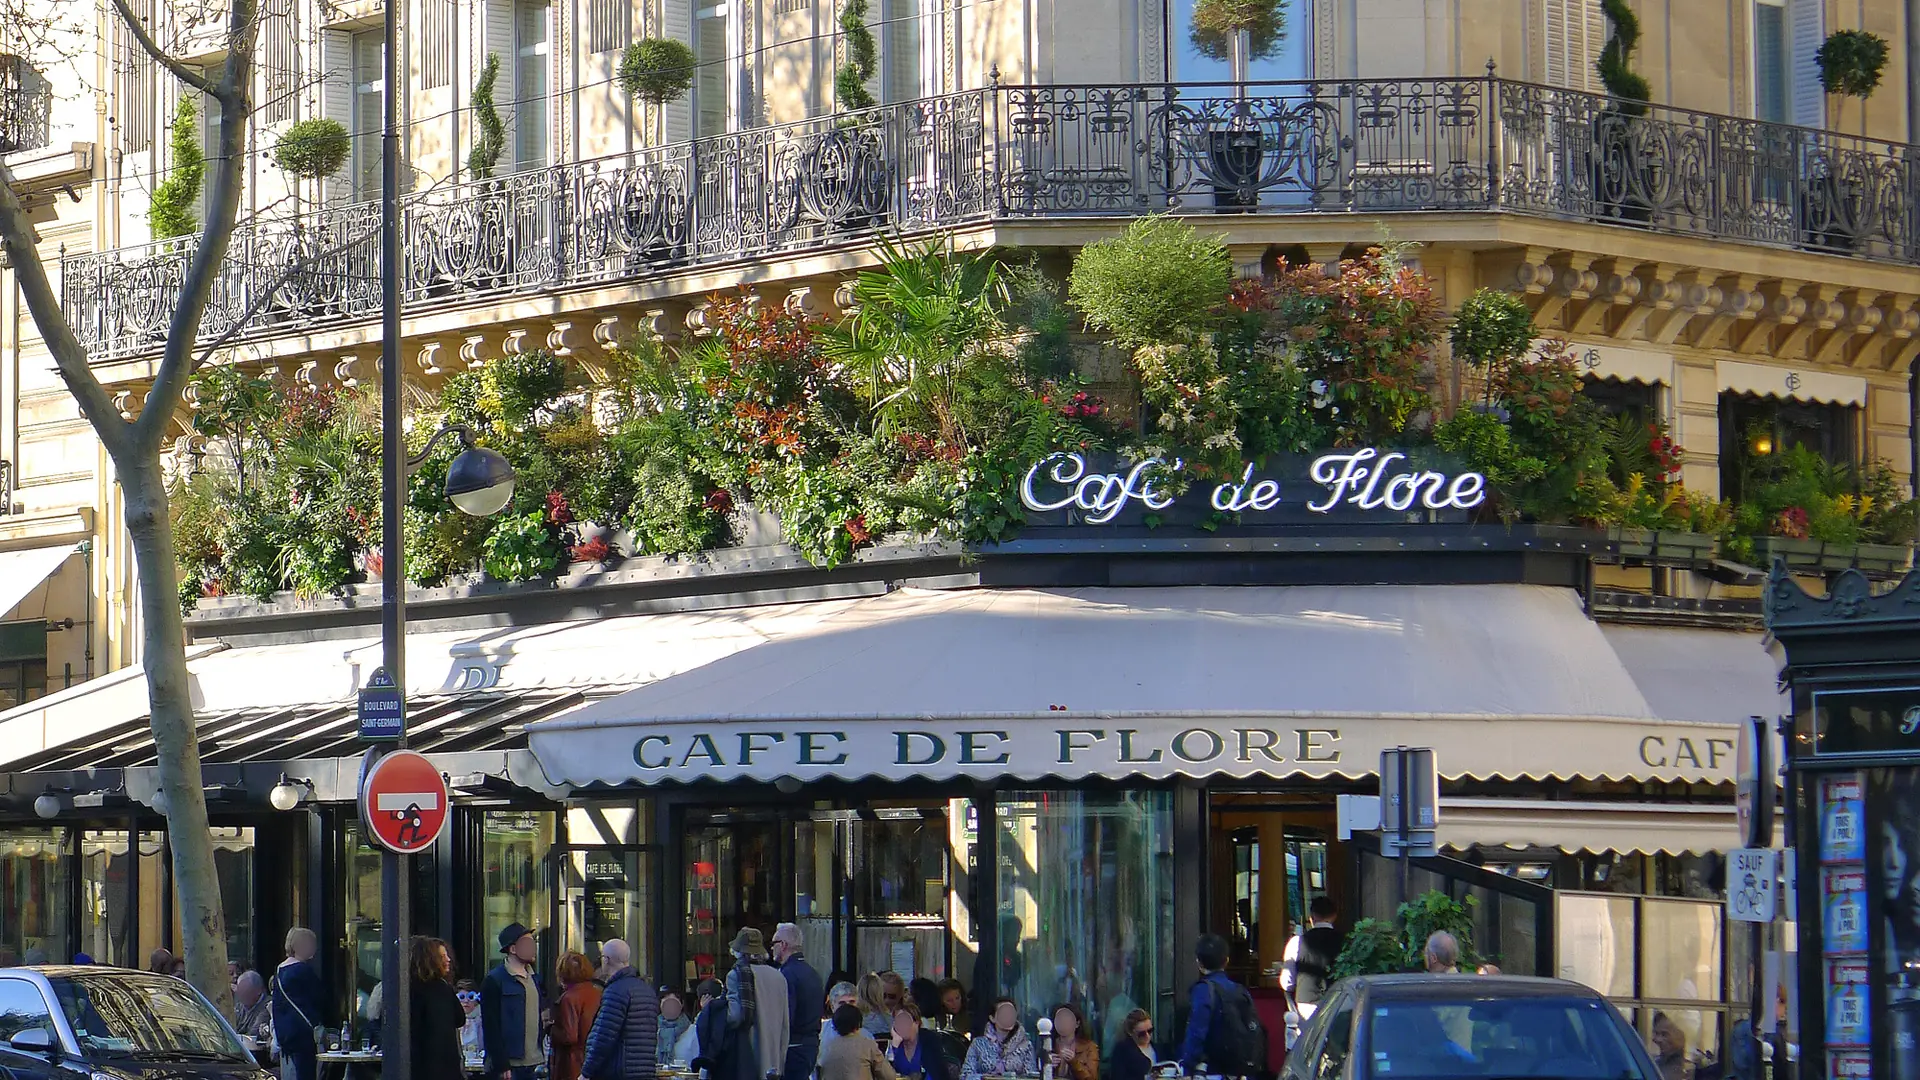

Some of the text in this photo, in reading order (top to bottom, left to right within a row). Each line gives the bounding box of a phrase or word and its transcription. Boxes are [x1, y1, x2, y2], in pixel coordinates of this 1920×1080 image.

[1211, 461, 1281, 512] de
[1307, 447, 1485, 512] Flore
[364, 701, 399, 711] BOULEVARD
[632, 728, 1342, 770] CAFE DE FLORE
[1639, 735, 1736, 769] CAF
[1738, 854, 1763, 871] SAUF
